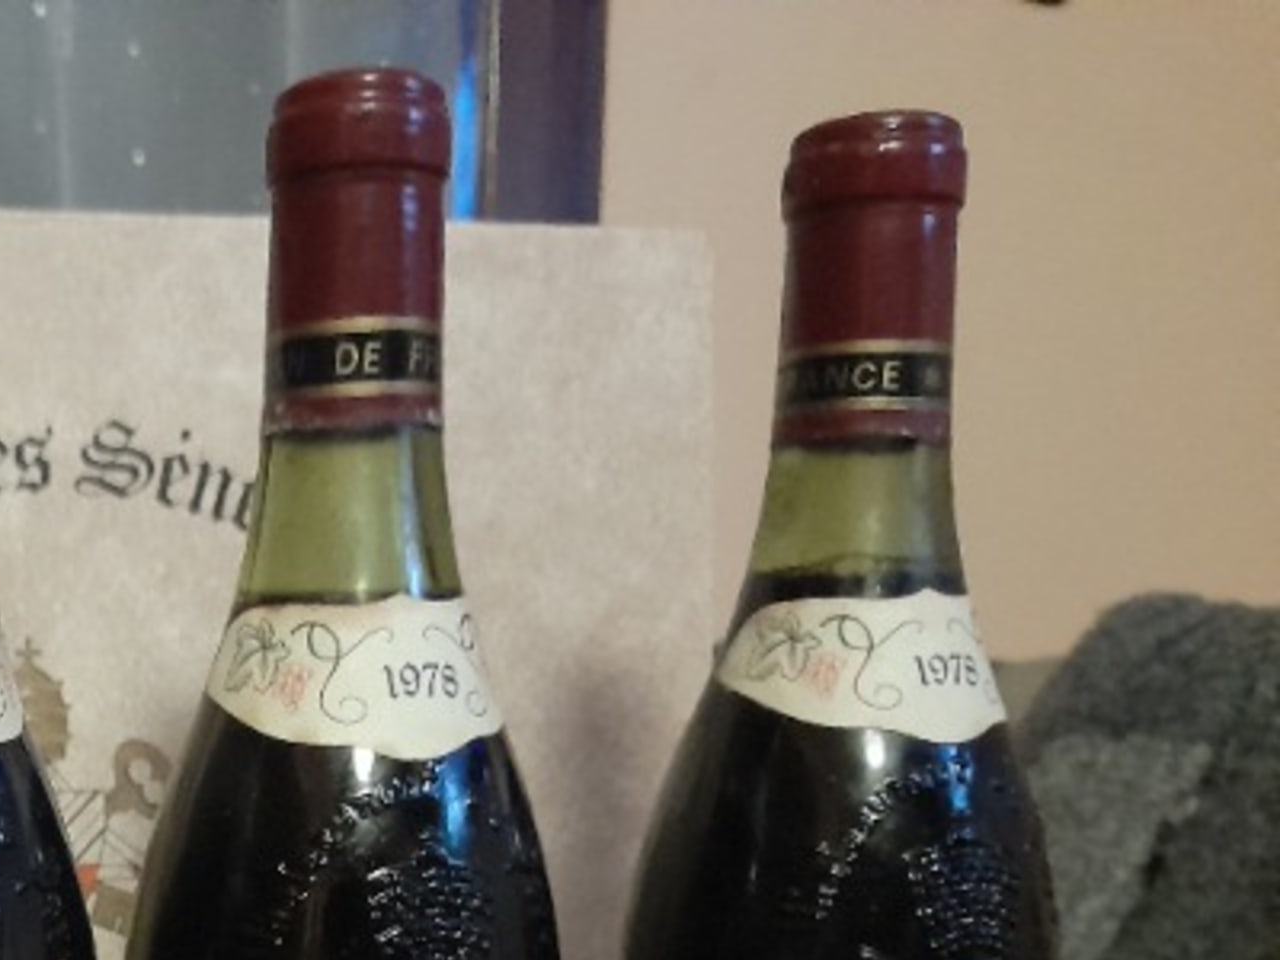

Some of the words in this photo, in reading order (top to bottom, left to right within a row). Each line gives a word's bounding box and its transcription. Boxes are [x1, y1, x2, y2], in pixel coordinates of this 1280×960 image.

[335, 341, 383, 377] DE
[384, 661, 459, 700] 1978
[915, 654, 978, 687] 1978
